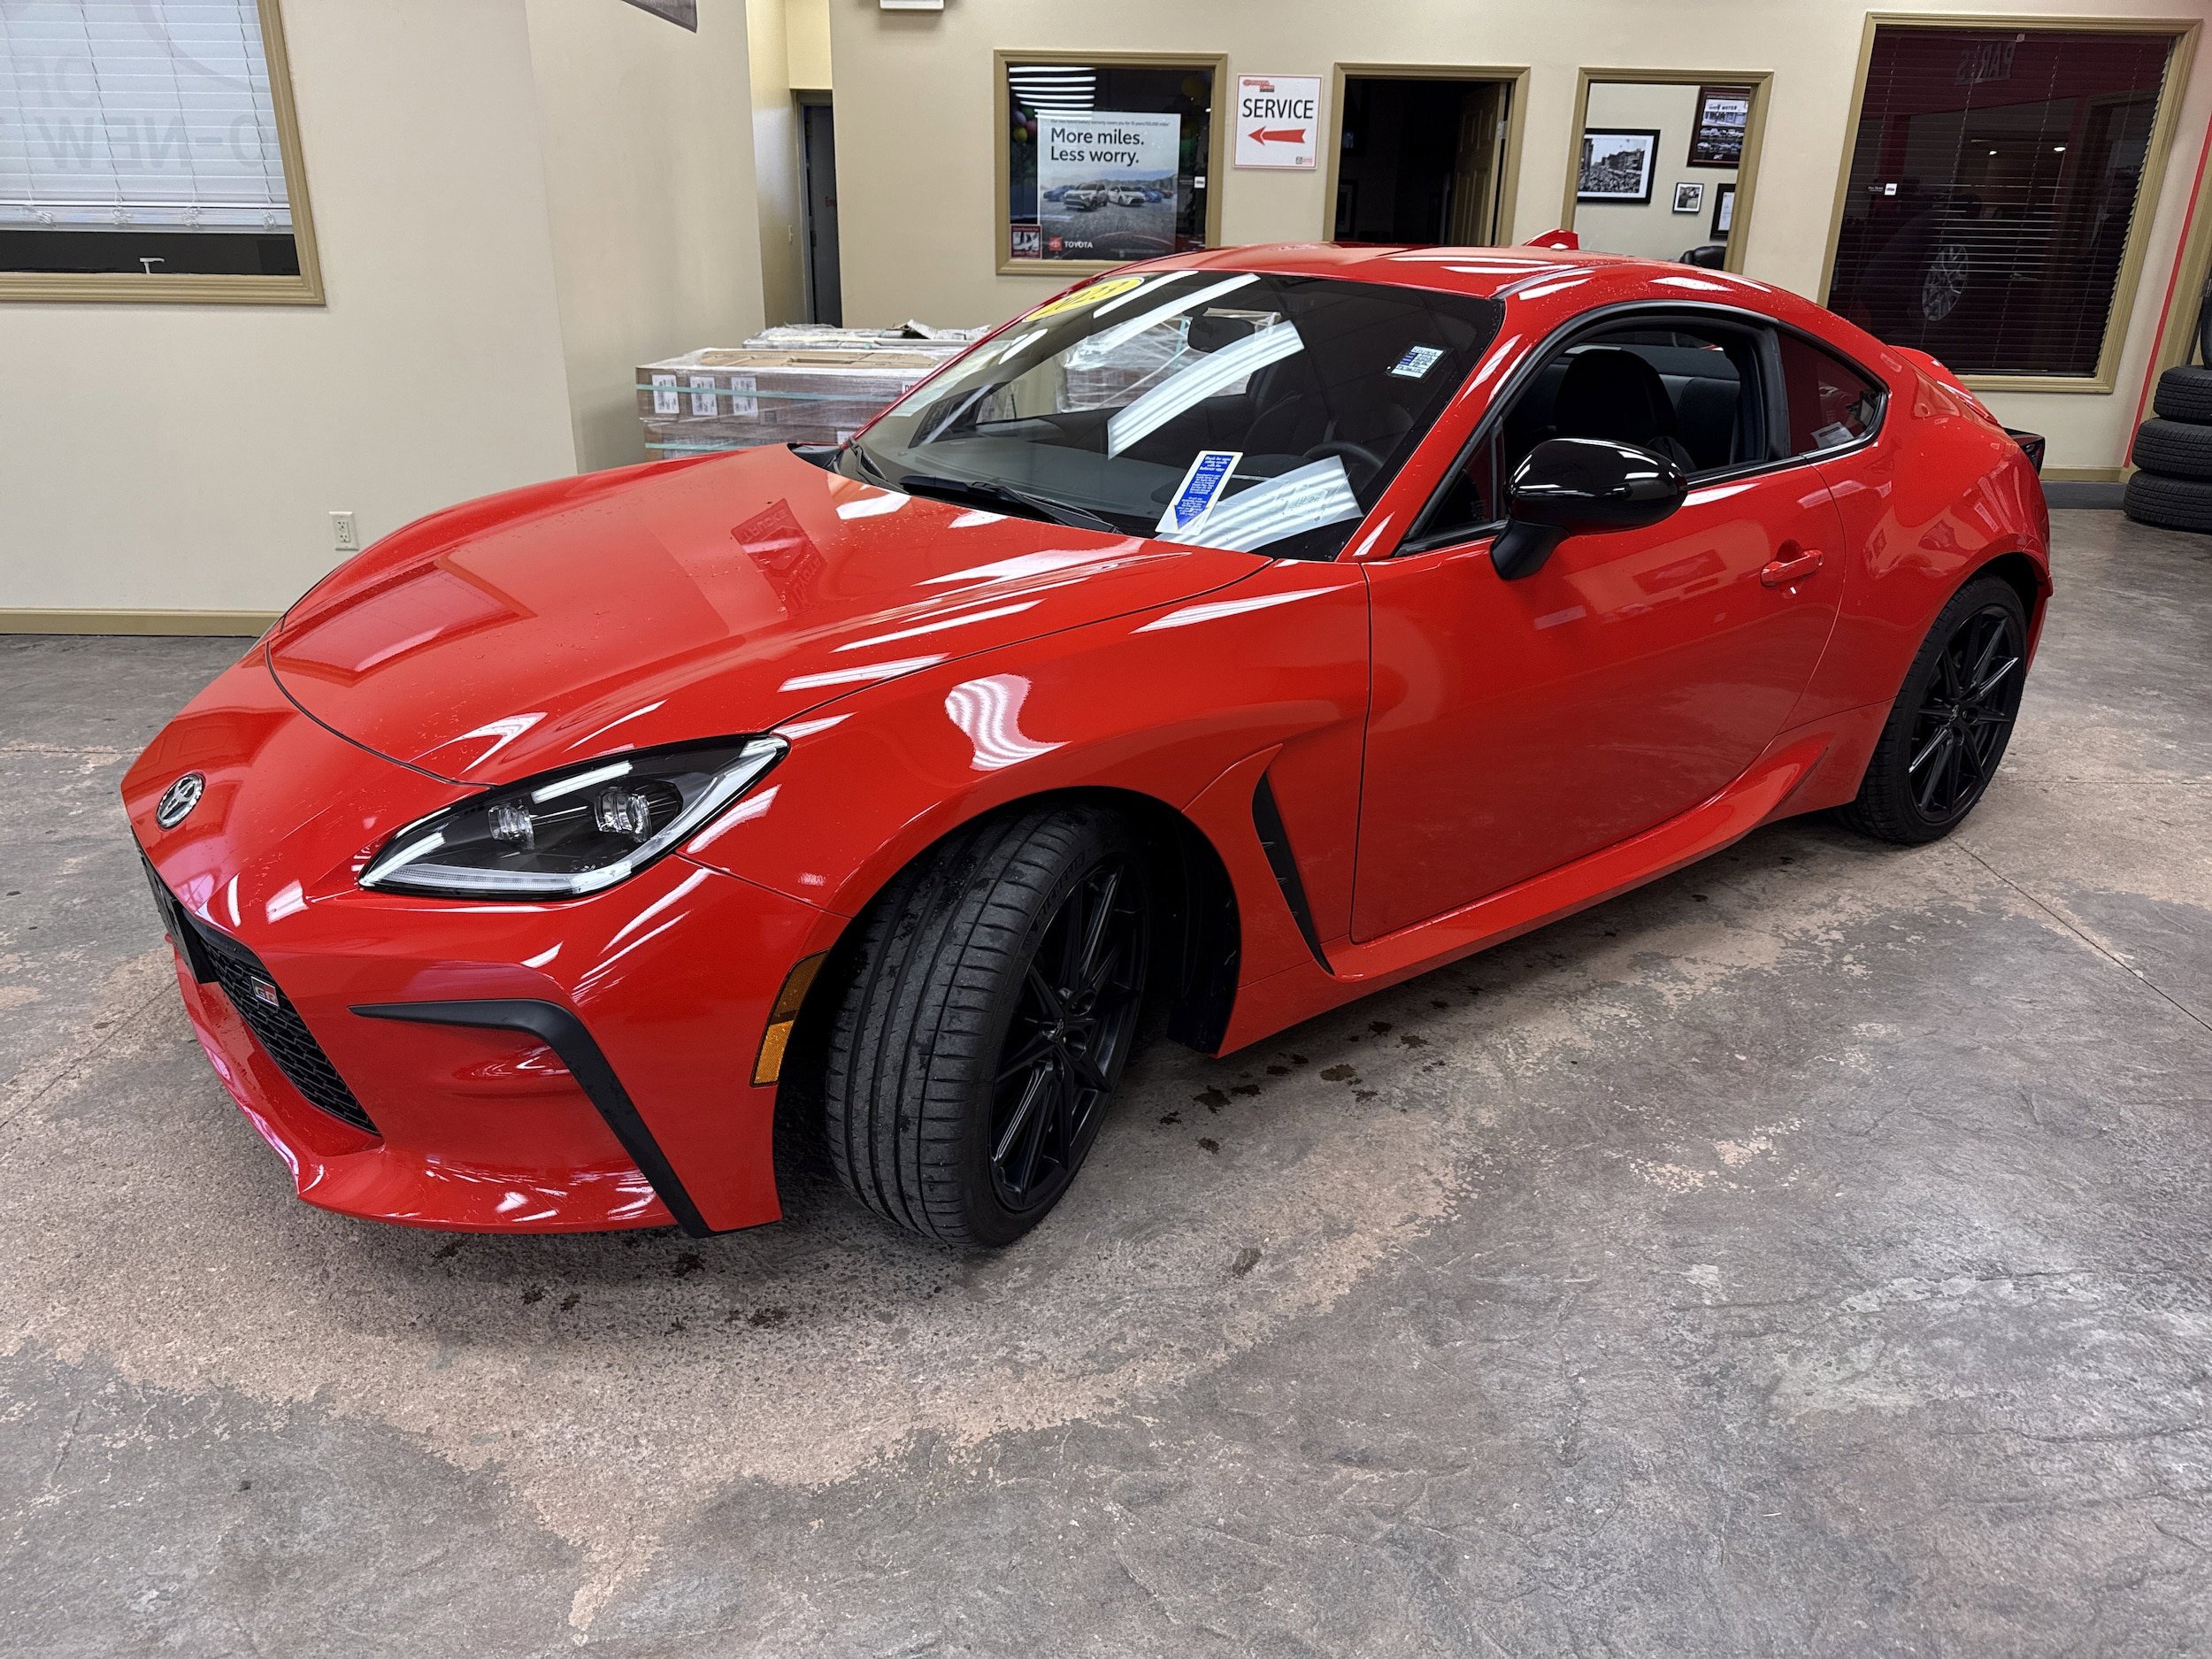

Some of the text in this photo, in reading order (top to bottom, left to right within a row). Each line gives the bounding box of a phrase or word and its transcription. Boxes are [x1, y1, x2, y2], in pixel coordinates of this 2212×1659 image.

[1242, 98, 1314, 119] SERVICE
[1050, 127, 1144, 145] More miles.
[1050, 146, 1139, 166] Less worry.
[254, 986, 279, 1005] GR
